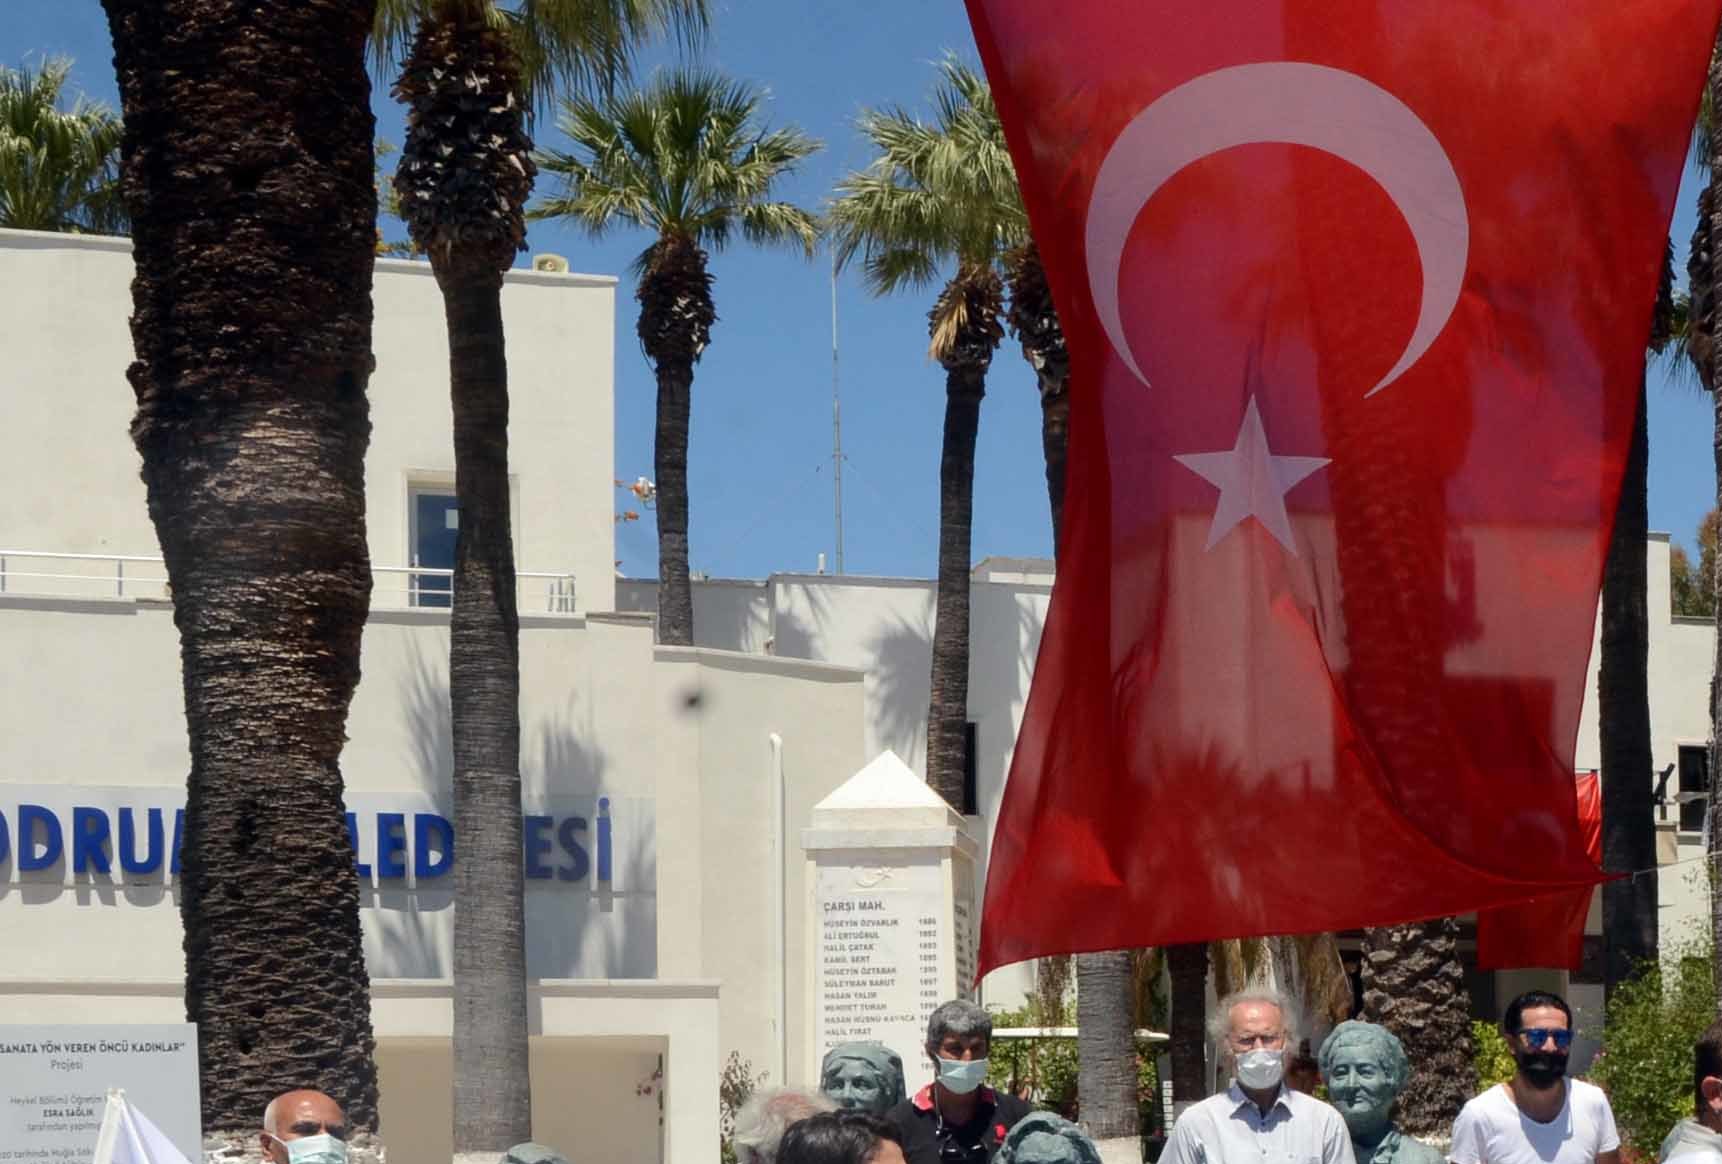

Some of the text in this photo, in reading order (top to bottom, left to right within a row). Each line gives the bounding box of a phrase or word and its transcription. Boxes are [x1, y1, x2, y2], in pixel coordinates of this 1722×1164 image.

[0, 804, 186, 874] DRU
[858, 901, 885, 911] MAH.
[40, 1040, 61, 1053] YÖN
[64, 1042, 96, 1053] VEREN
[99, 1040, 128, 1053] ÖNCÜ
[50, 1059, 83, 1072] Projesi
